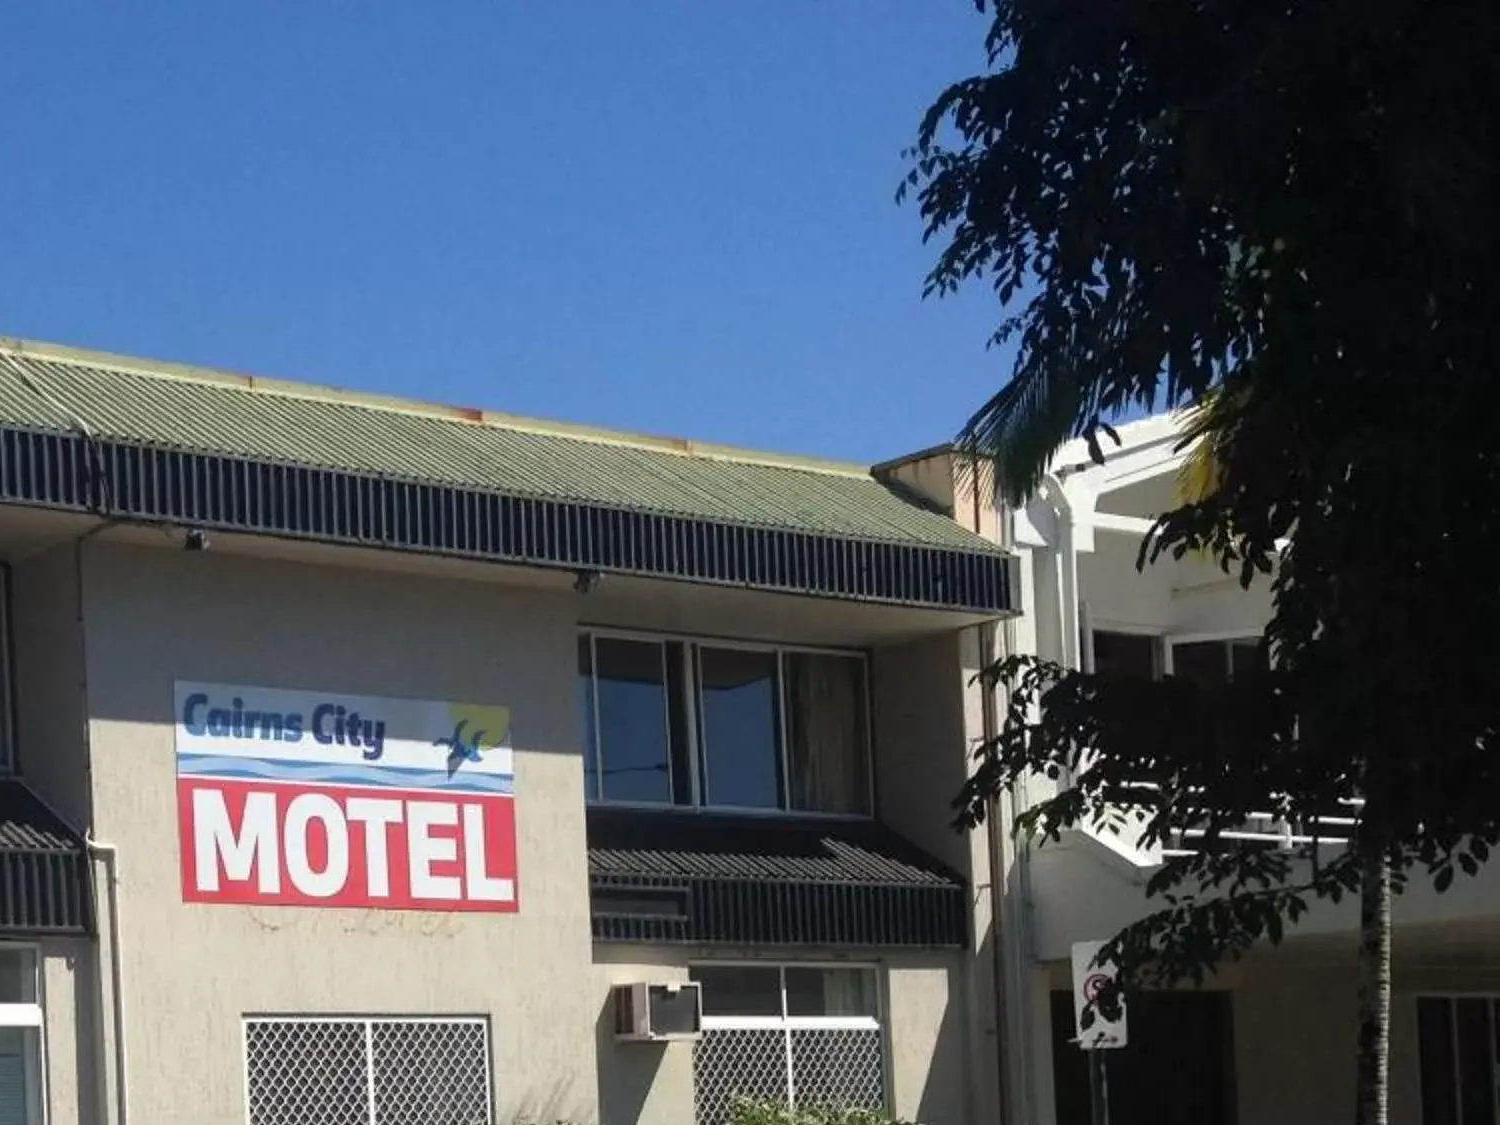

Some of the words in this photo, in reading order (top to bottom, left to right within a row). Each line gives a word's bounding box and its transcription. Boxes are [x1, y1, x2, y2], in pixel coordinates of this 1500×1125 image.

[183, 692, 304, 744] Cairns
[312, 702, 386, 761] City
[192, 788, 515, 902] MOTEL
